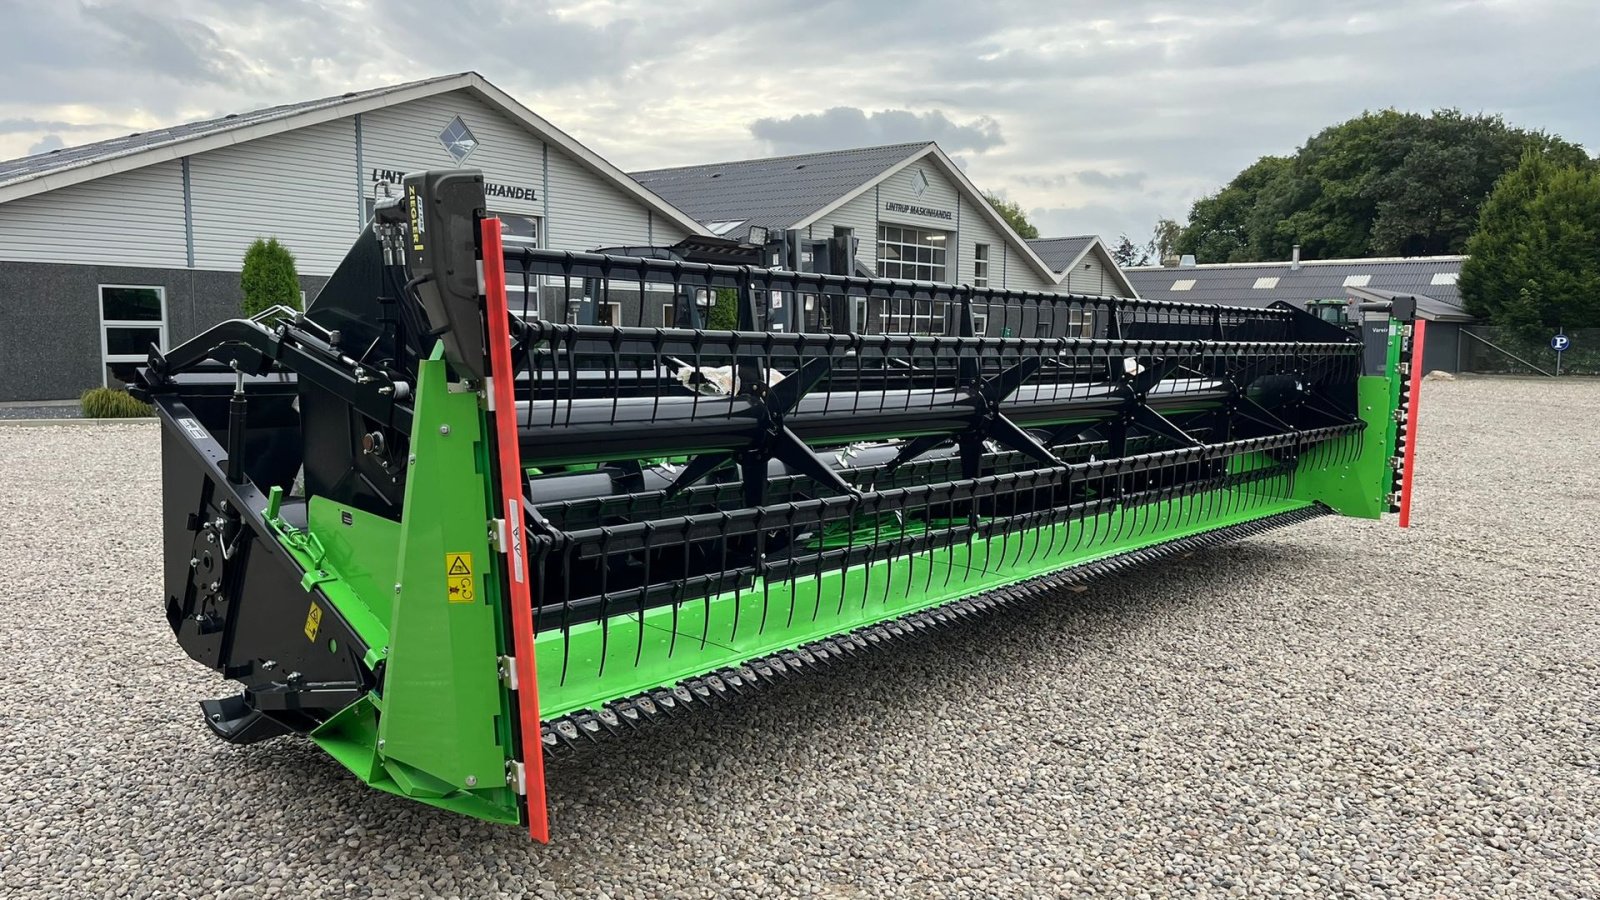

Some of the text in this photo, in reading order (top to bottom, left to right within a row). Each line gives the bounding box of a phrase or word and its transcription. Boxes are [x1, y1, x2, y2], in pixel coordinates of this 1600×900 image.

[485, 183, 538, 201] HANDEL
[408, 185, 419, 243] ZIEGLER
[885, 202, 953, 220] LINTRUP MASKINHANDEL
[1554, 336, 1567, 348] P
